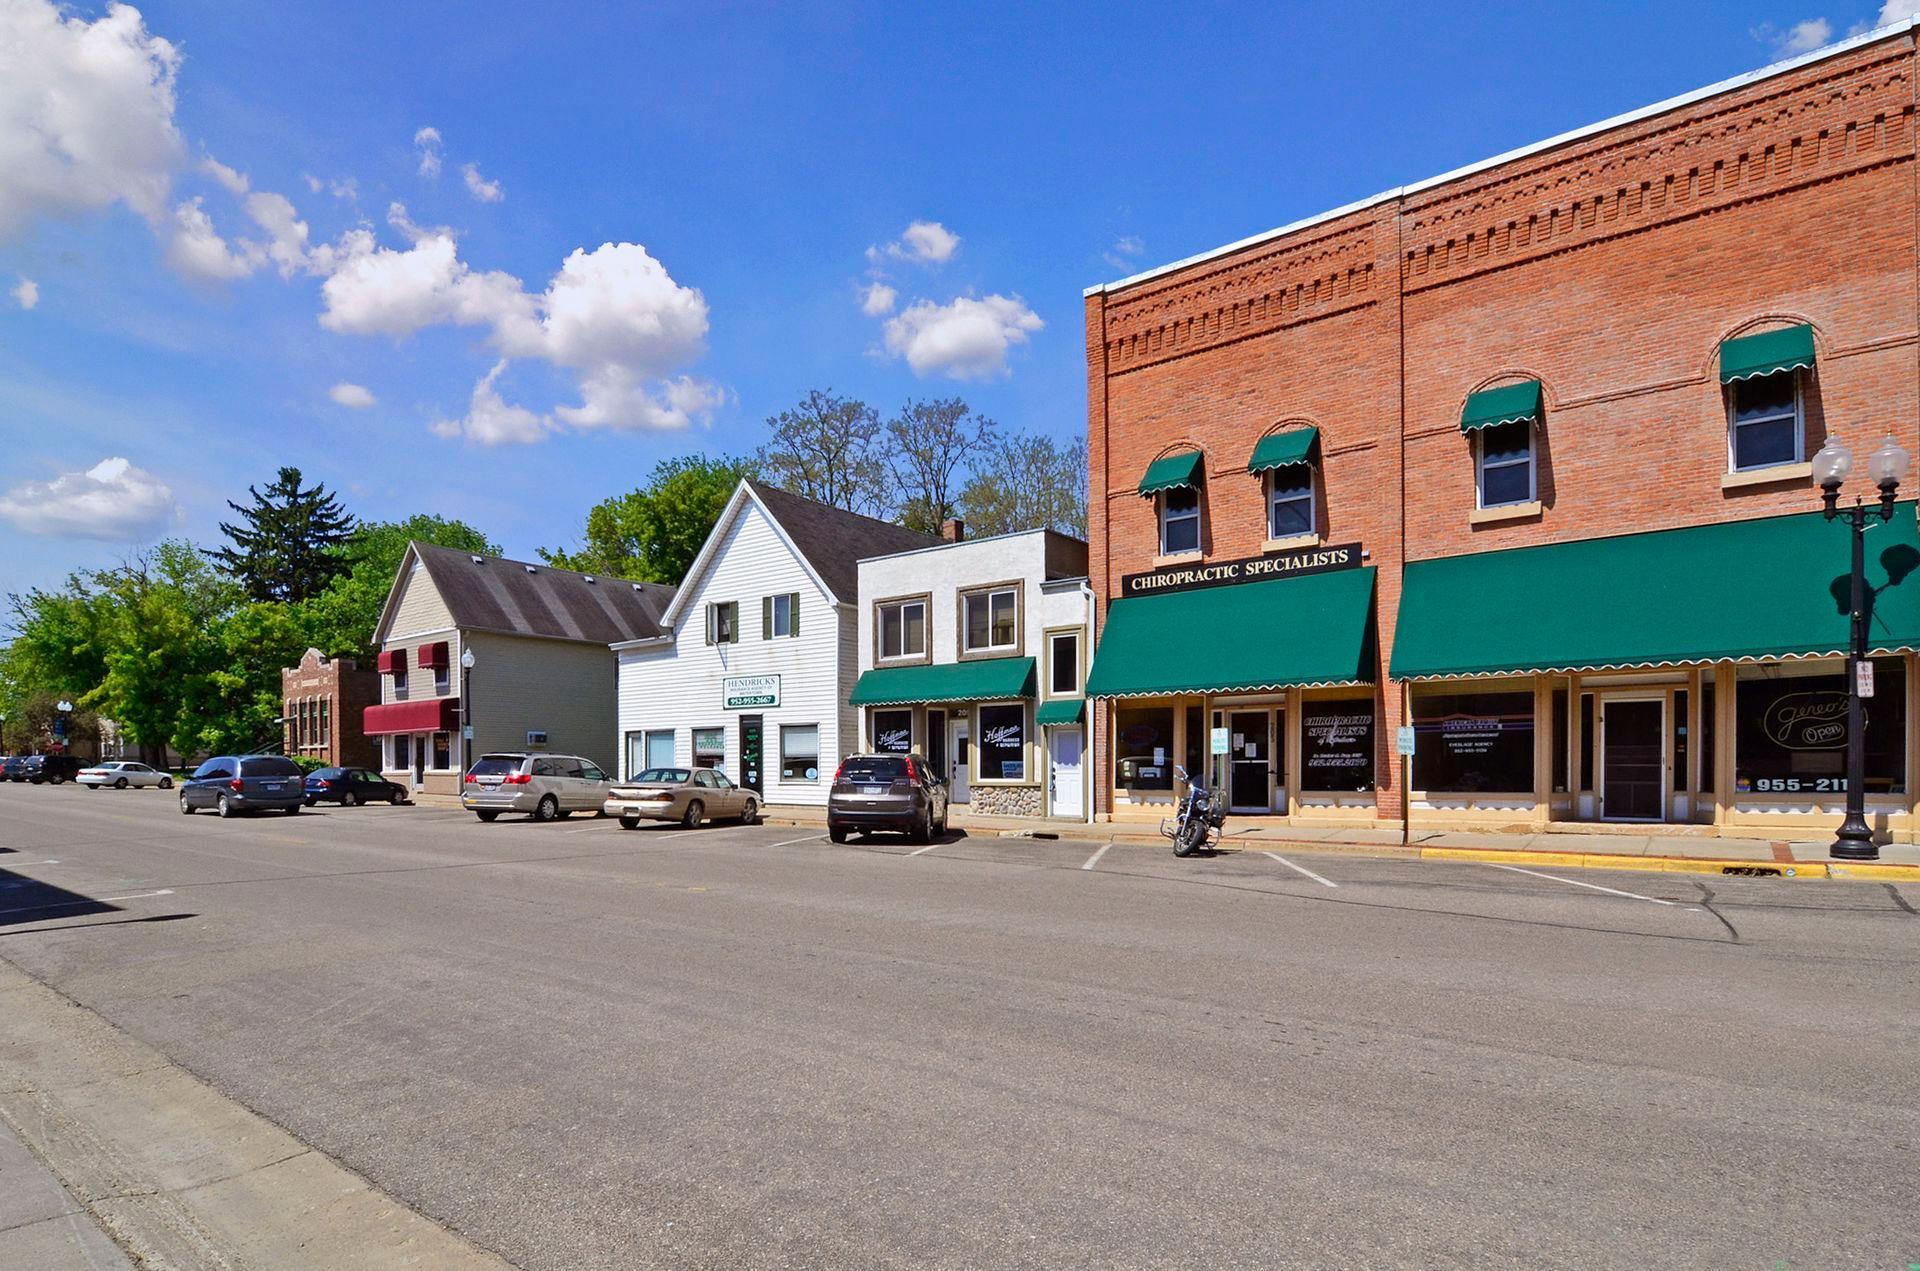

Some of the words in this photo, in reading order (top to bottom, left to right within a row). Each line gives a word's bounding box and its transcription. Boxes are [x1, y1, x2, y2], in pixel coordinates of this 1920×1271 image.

[1131, 564, 1239, 590] CHIROPRACTIC
[1245, 549, 1349, 576] SPECIALISTS
[728, 677, 776, 688] HENDRICKS
[730, 696, 772, 705] 952-955-2667
[1304, 715, 1372, 726] CHIROPRACTIC
[1308, 726, 1368, 737] SPECIALISTS
[1805, 724, 1842, 742] Open
